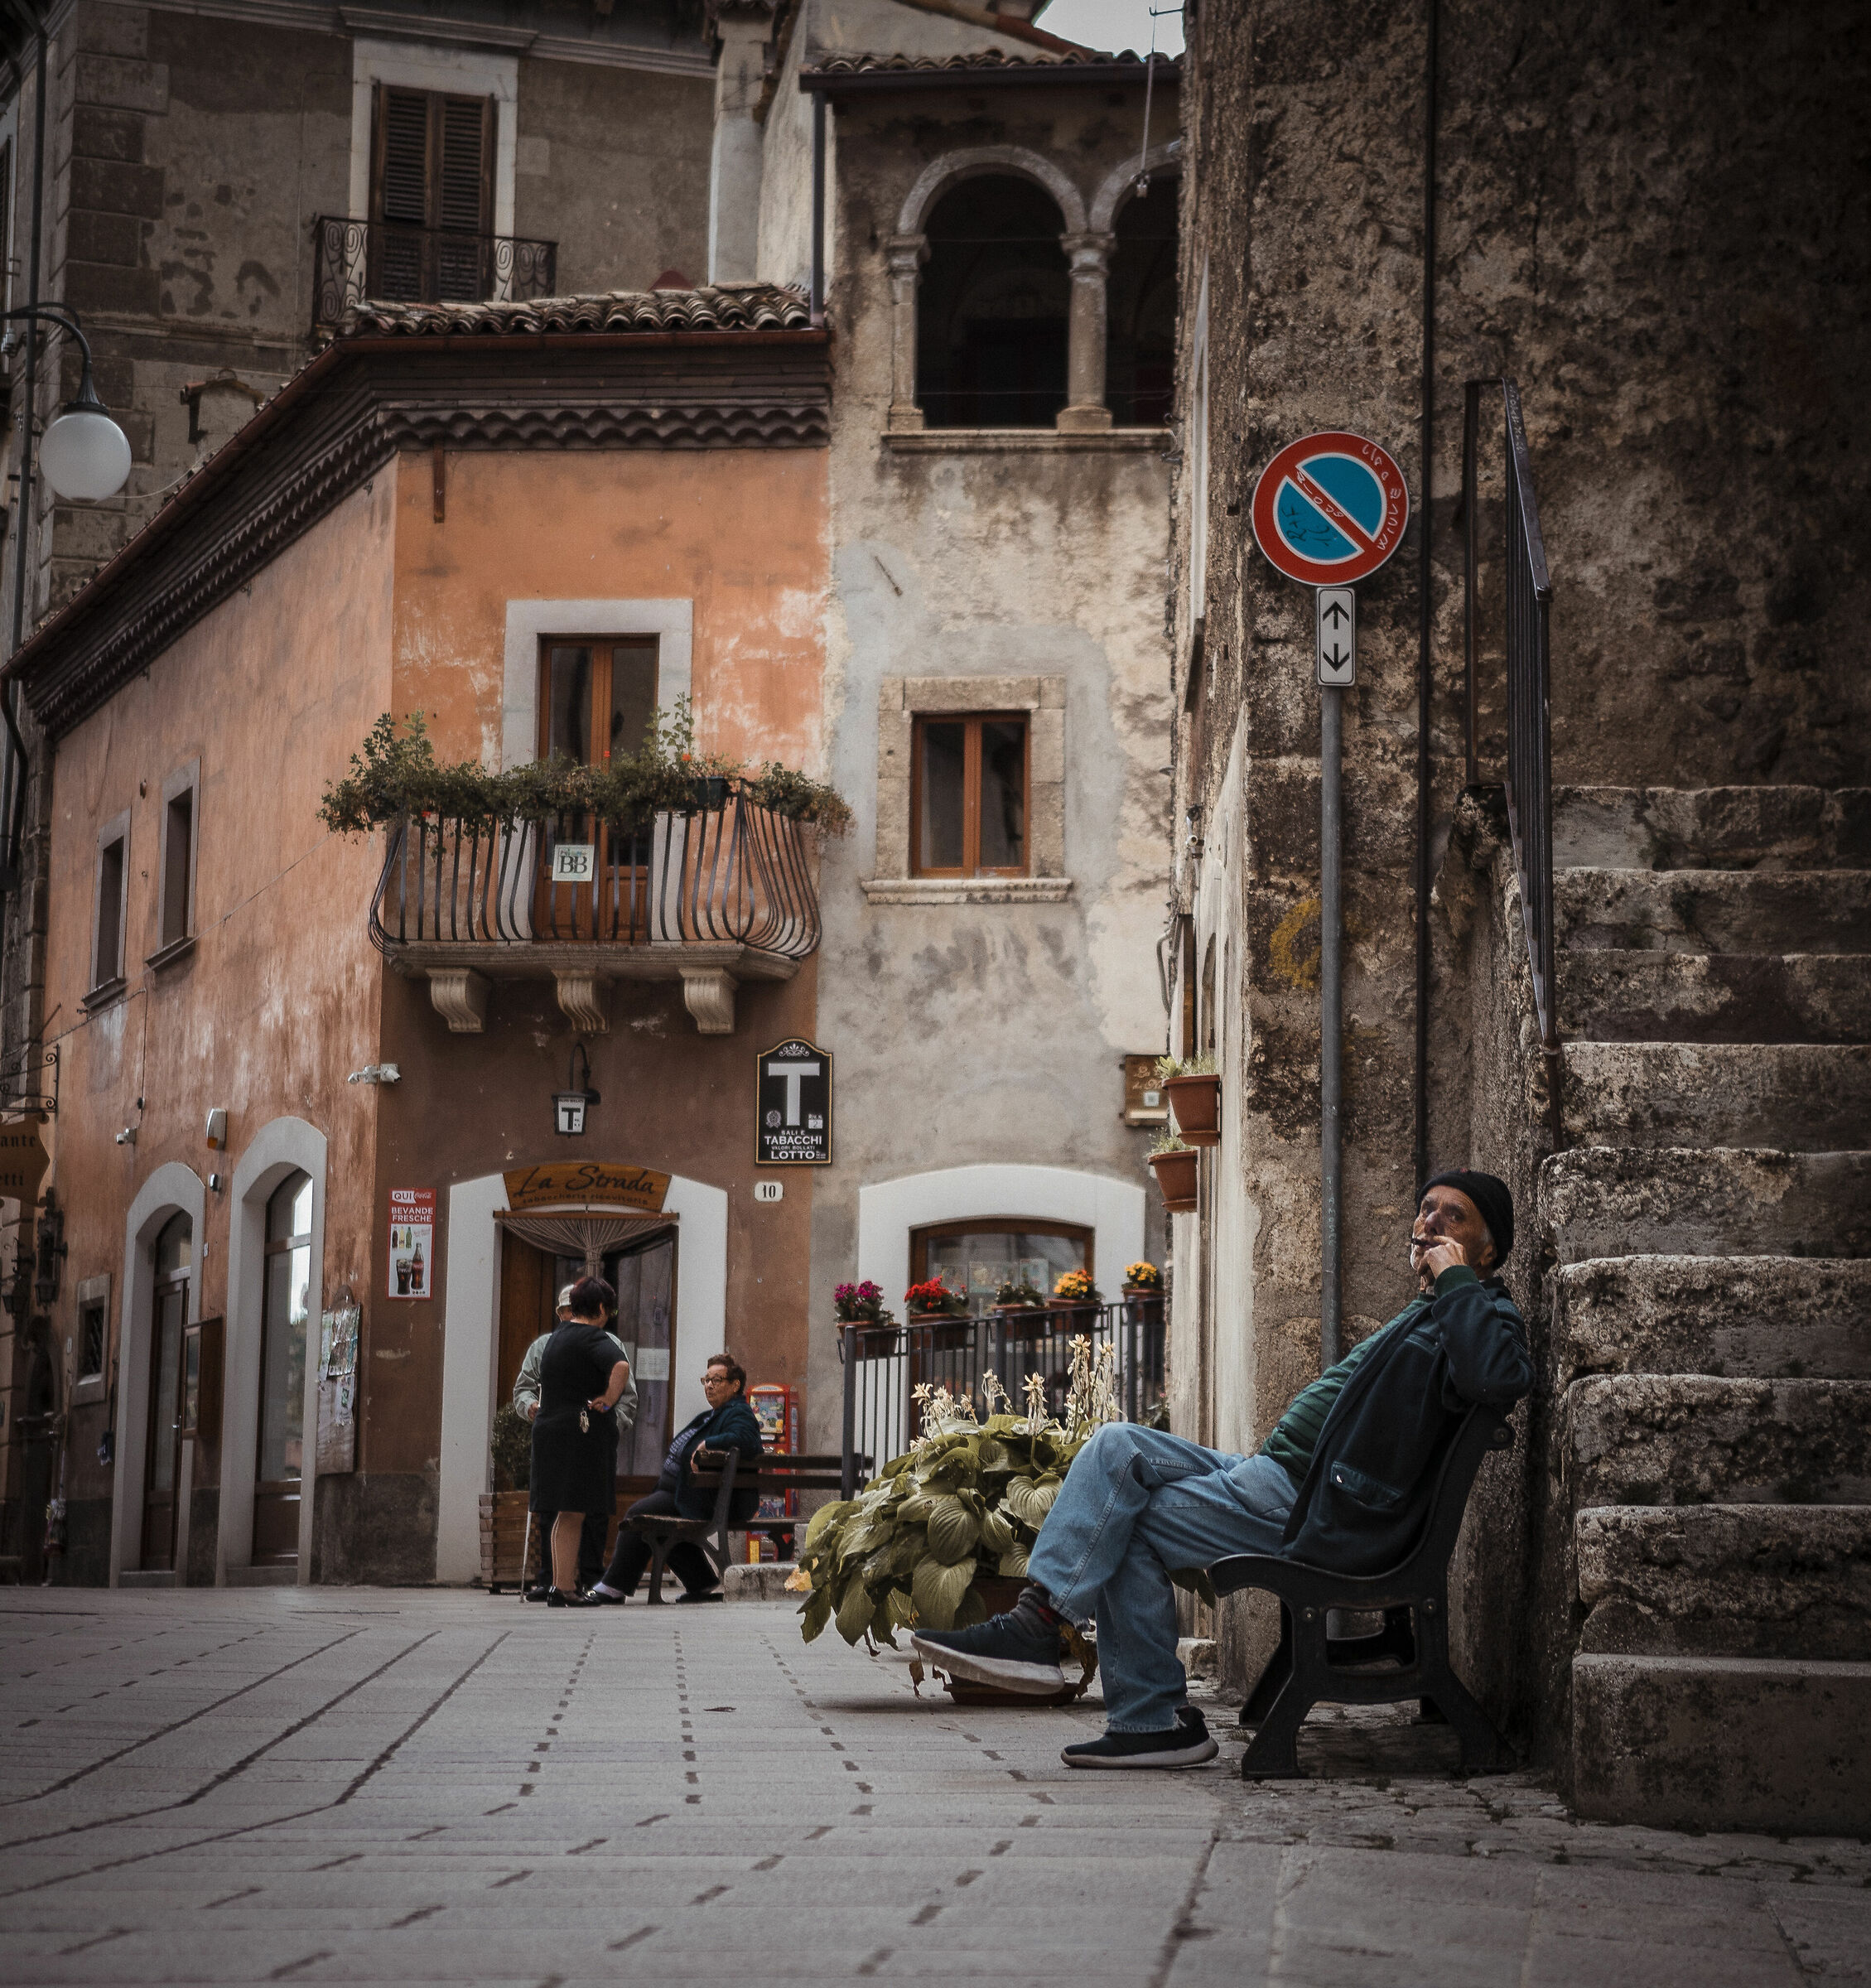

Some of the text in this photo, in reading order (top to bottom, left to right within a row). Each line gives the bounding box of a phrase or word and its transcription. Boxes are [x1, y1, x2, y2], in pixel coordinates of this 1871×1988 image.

[768, 1062, 820, 1127] T
[561, 1107, 581, 1131] T
[764, 1136, 822, 1146] TABACCHI
[770, 1151, 816, 1160] LOTTO
[514, 1165, 655, 1198] La Strada
[394, 1192, 412, 1200] QUI
[763, 1185, 776, 1199] 10
[391, 1206, 433, 1215] BEVANDE
[392, 1214, 432, 1223] FRESCHE
